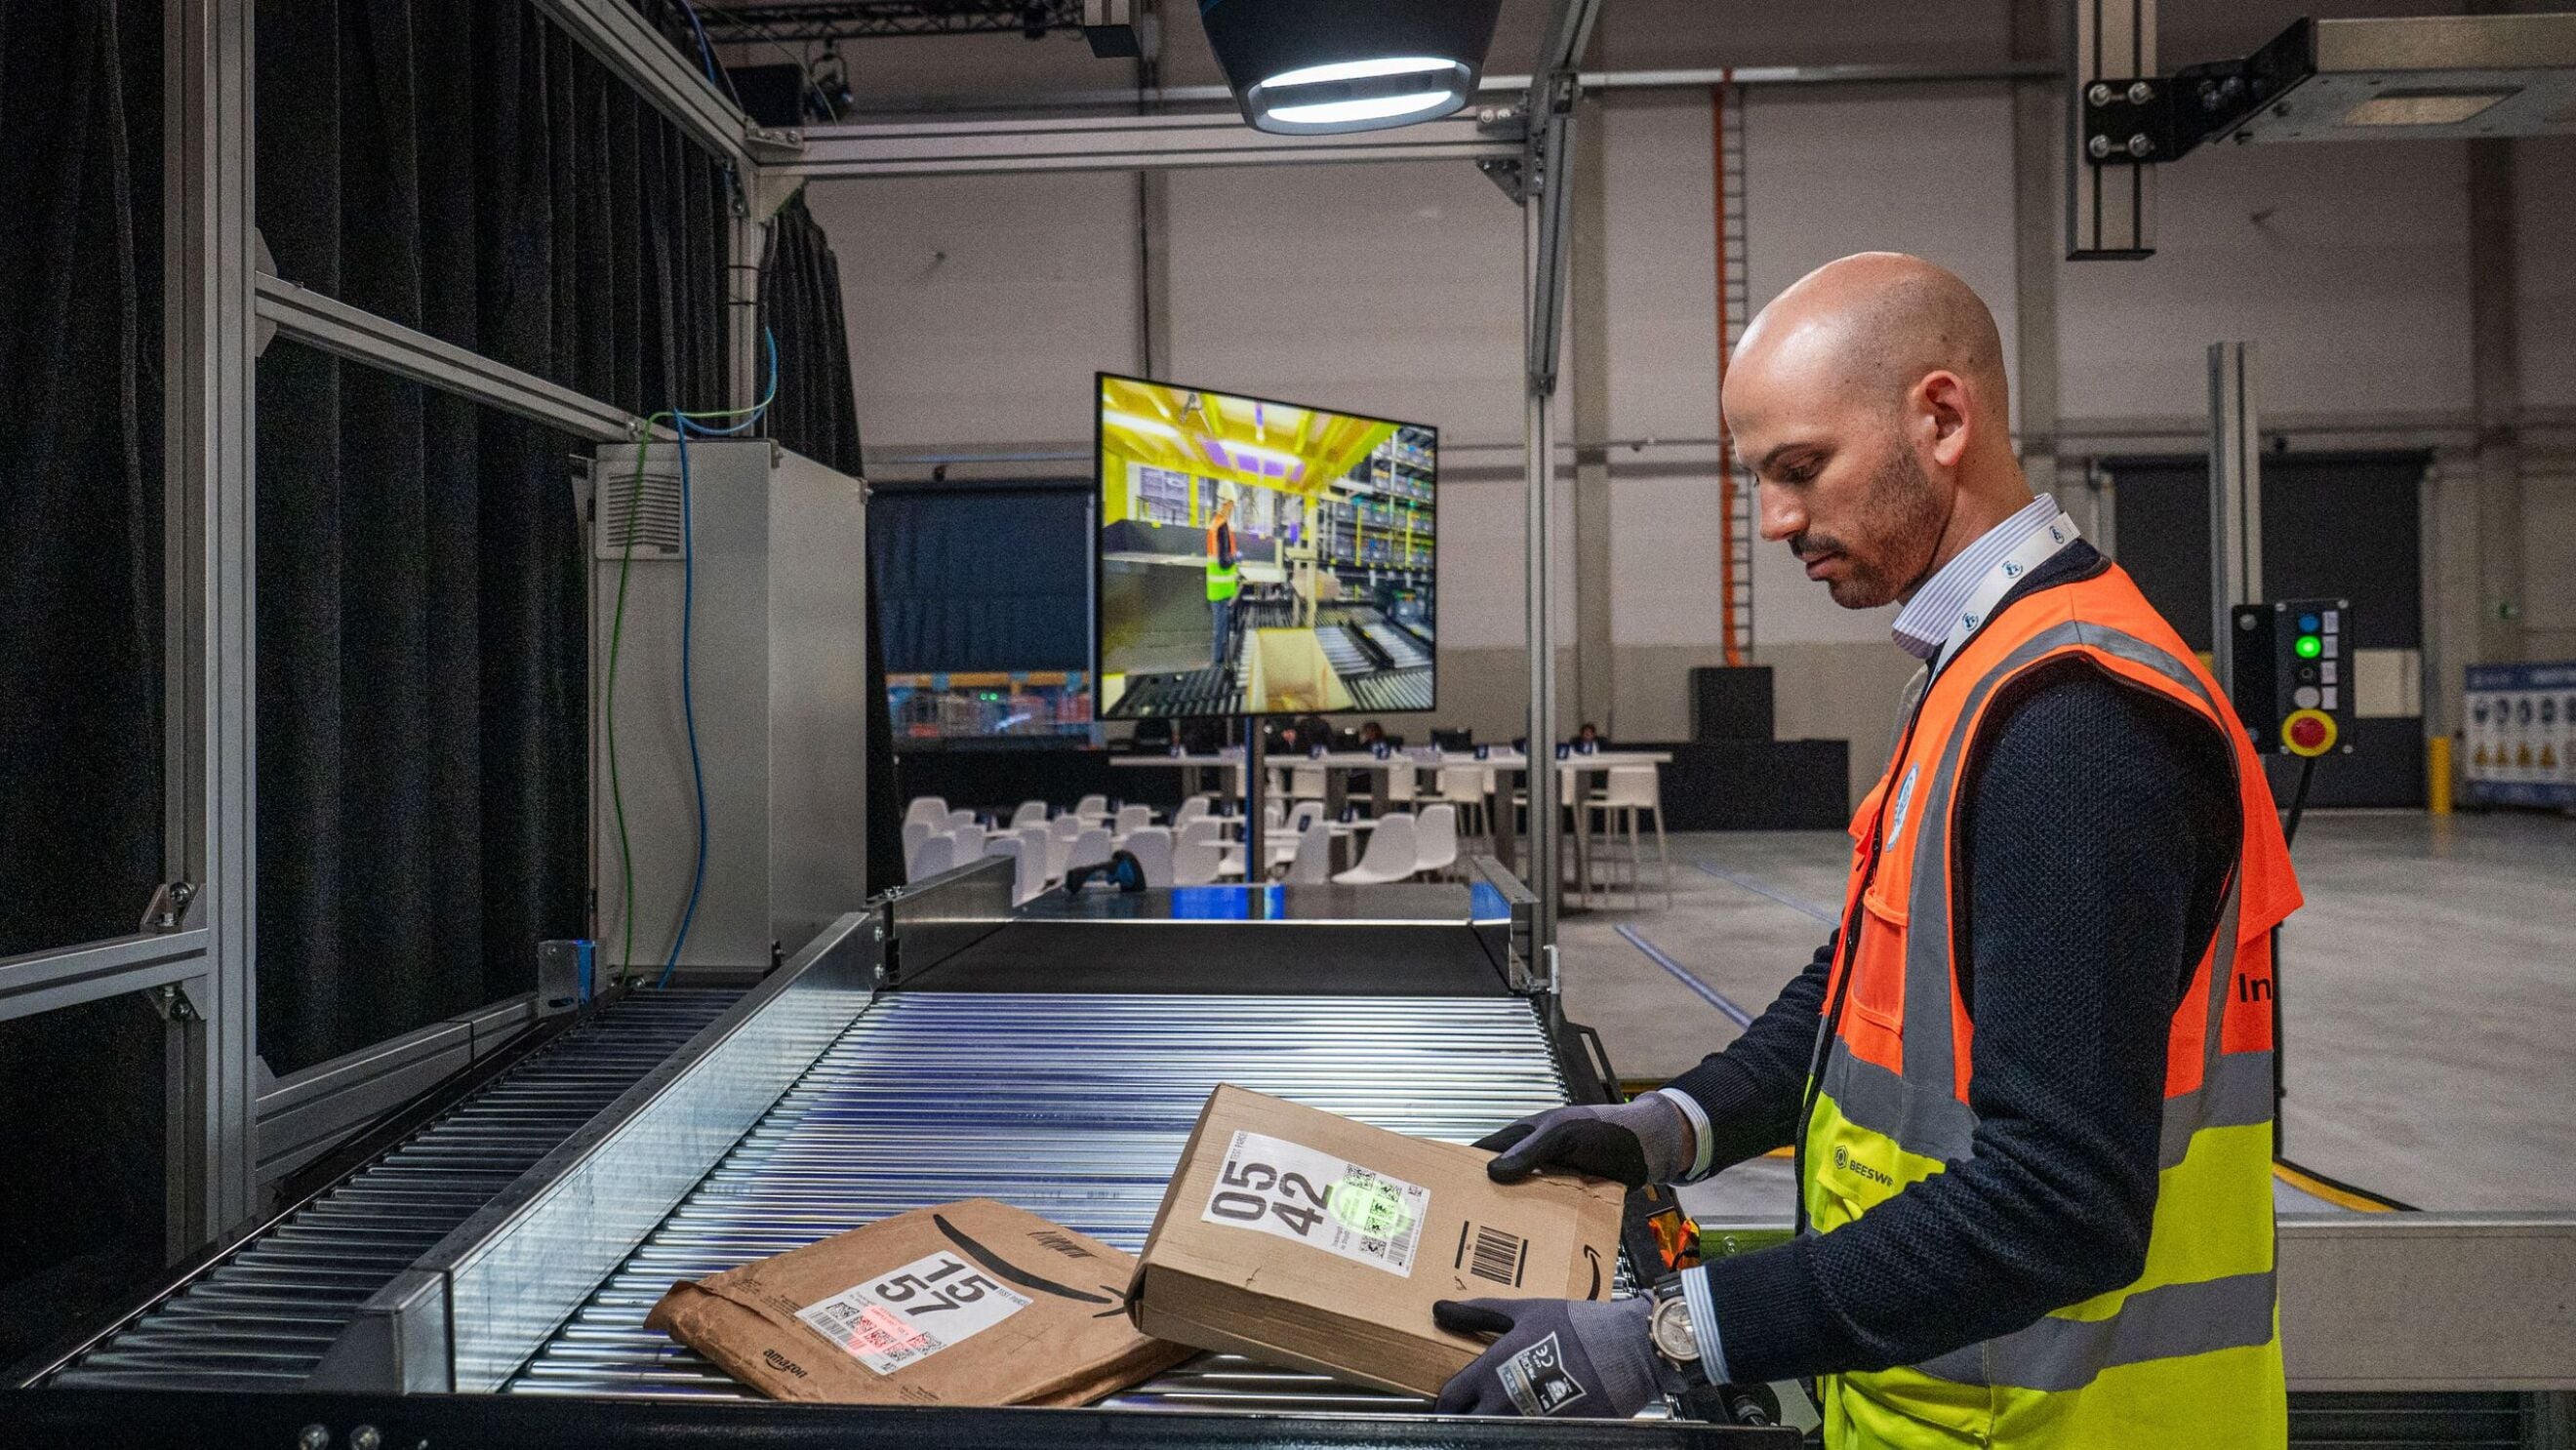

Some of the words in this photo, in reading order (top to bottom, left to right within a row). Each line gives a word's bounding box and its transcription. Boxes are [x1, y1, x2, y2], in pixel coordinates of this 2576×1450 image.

[2238, 972, 2272, 1002] In
[1210, 1160, 1278, 1222] 05
[1270, 1171, 1335, 1236] 42
[874, 1273, 960, 1317] 57
[923, 1258, 999, 1303] 15
[763, 1349, 808, 1379] amazon
